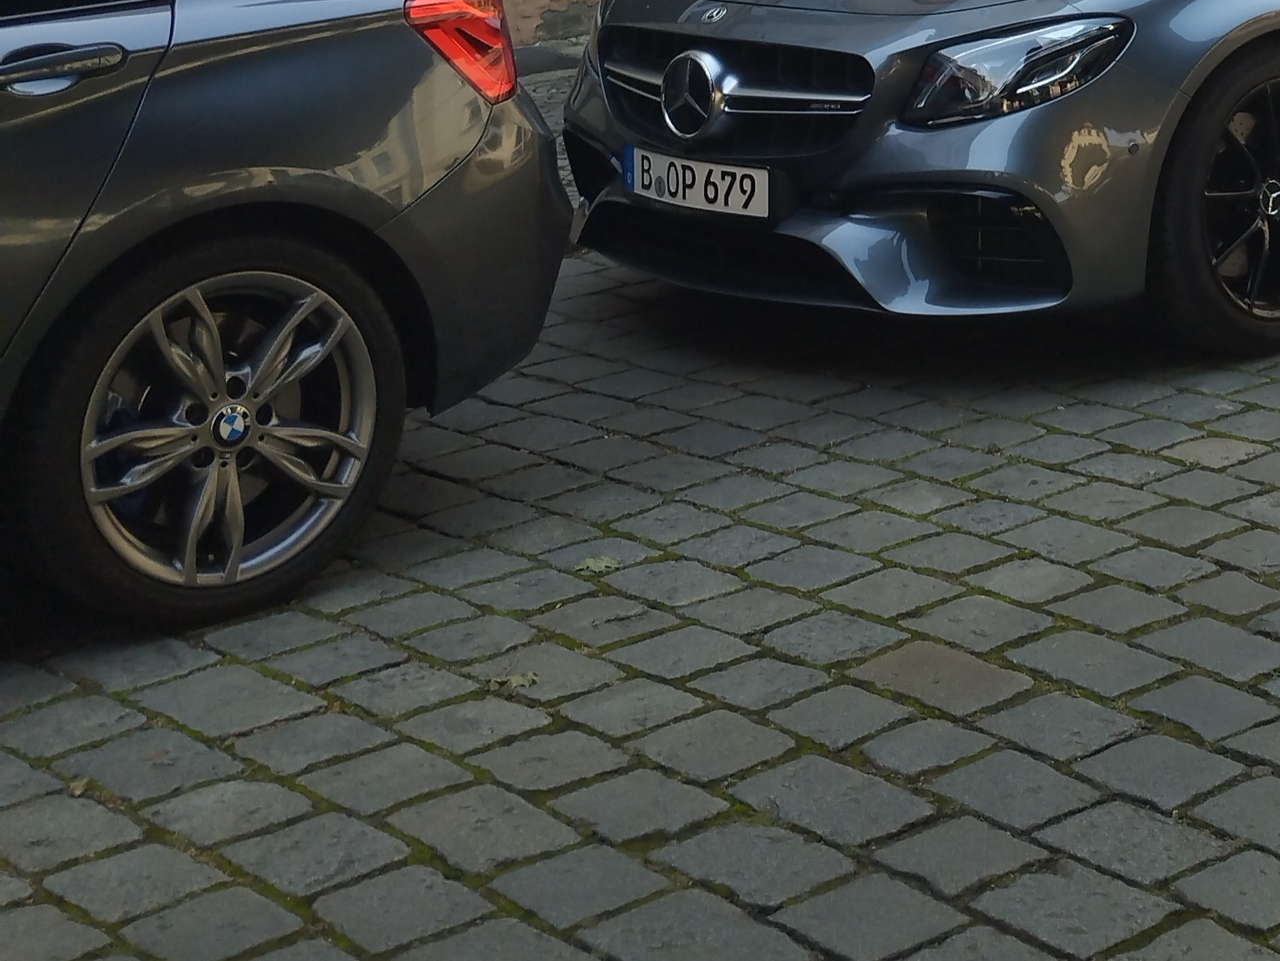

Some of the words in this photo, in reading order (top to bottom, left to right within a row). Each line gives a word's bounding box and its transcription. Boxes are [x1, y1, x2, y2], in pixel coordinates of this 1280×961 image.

[641, 154, 653, 191] B
[667, 161, 697, 200] OP
[704, 168, 756, 210] 679
